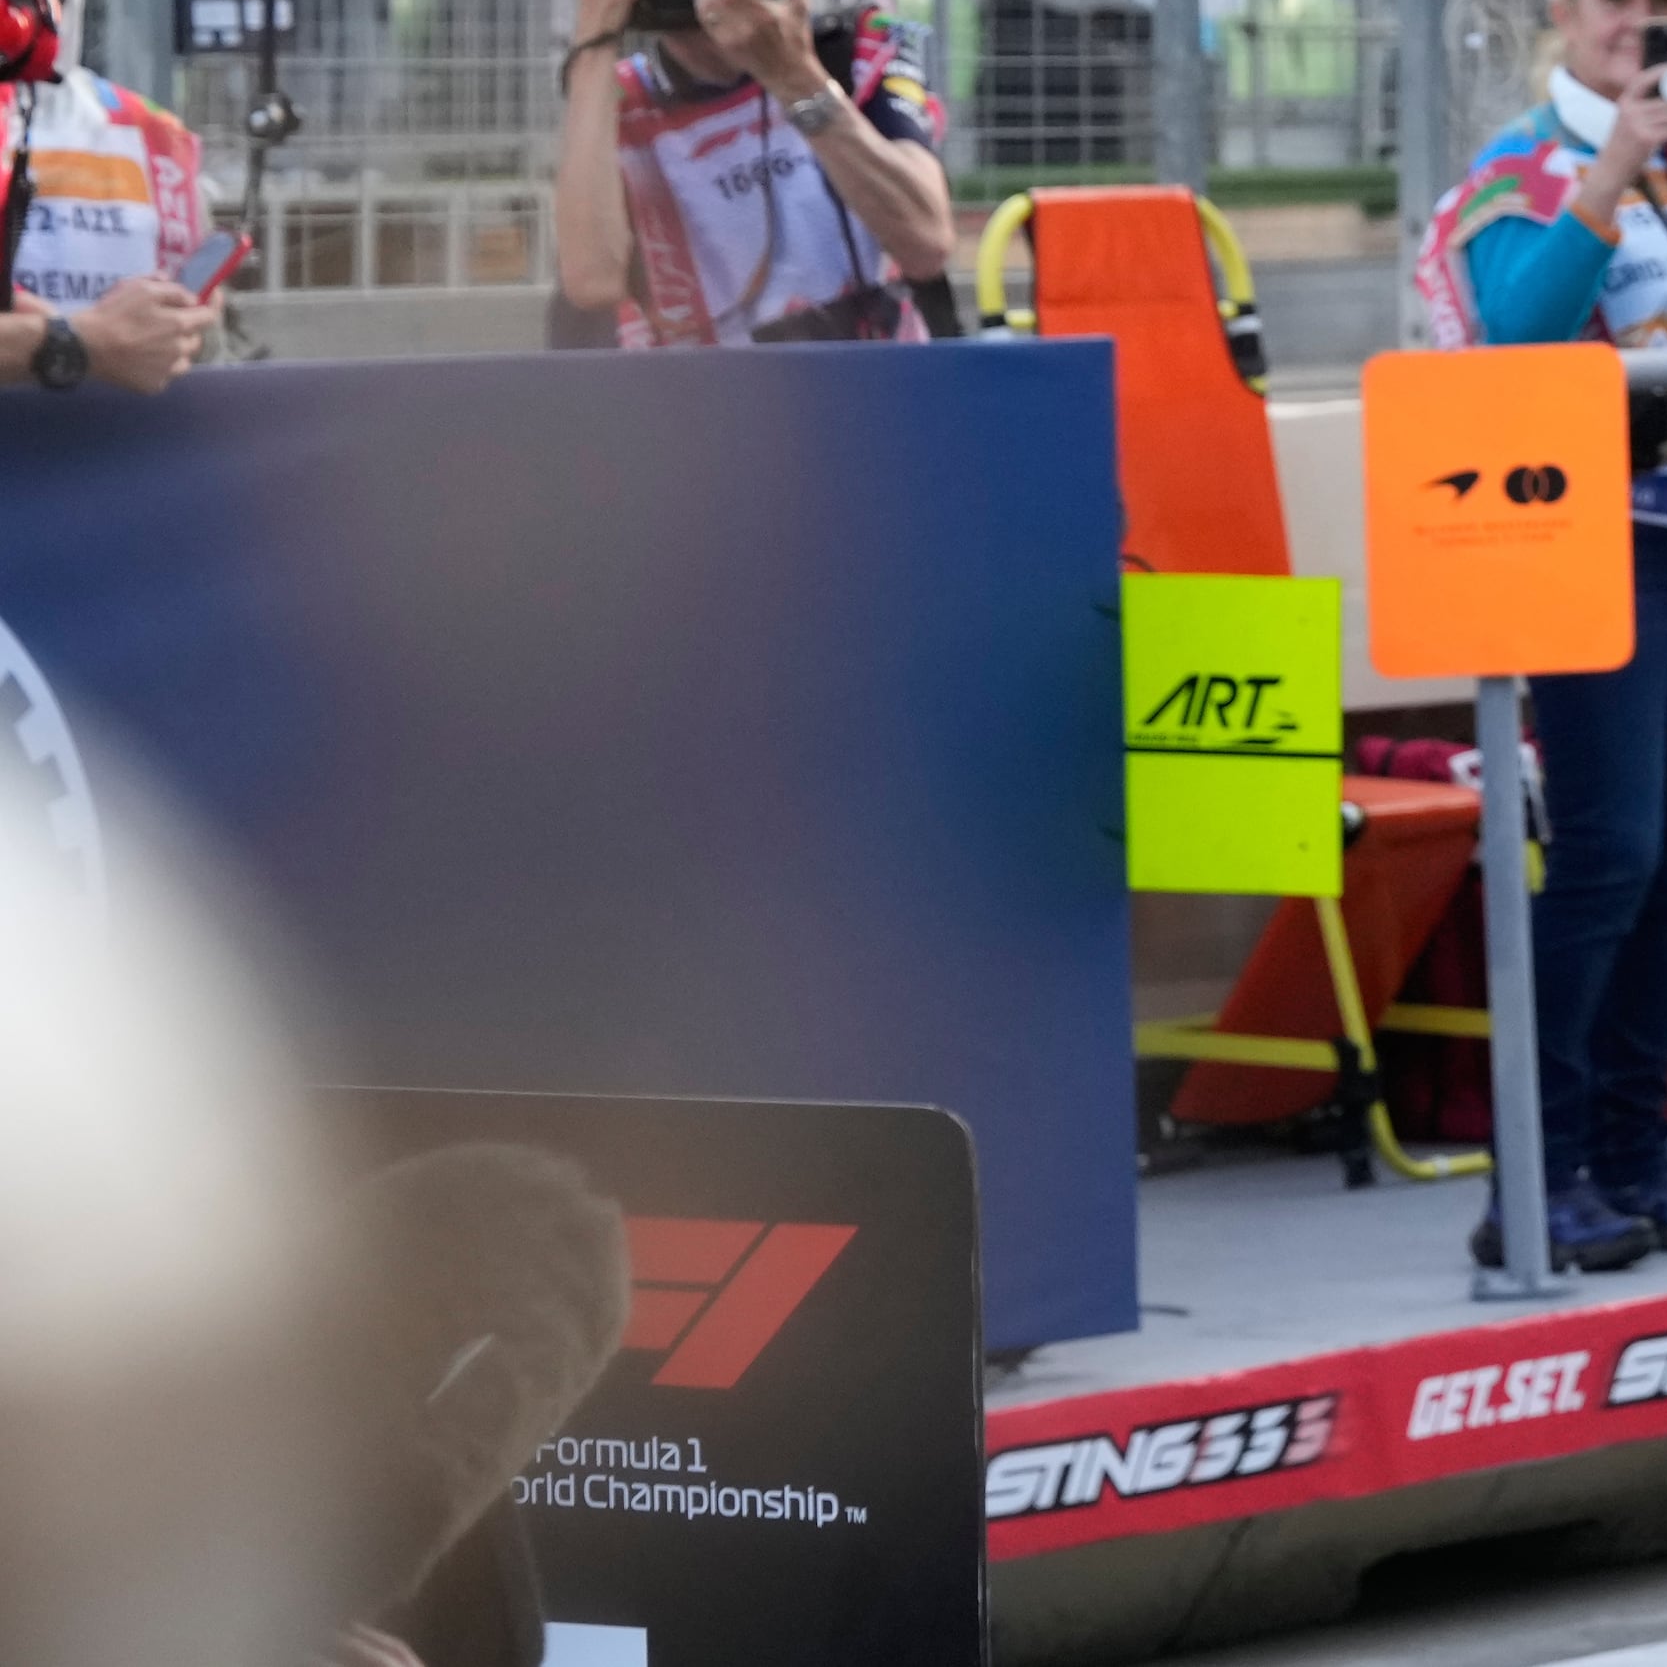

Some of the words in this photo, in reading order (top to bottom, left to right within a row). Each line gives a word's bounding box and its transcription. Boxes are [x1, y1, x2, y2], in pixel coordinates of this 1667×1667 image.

[1143, 673, 1282, 729] ART
[687, 1437, 707, 1472] 1
[512, 1471, 575, 1507] orld
[584, 1474, 838, 1528] Championship
